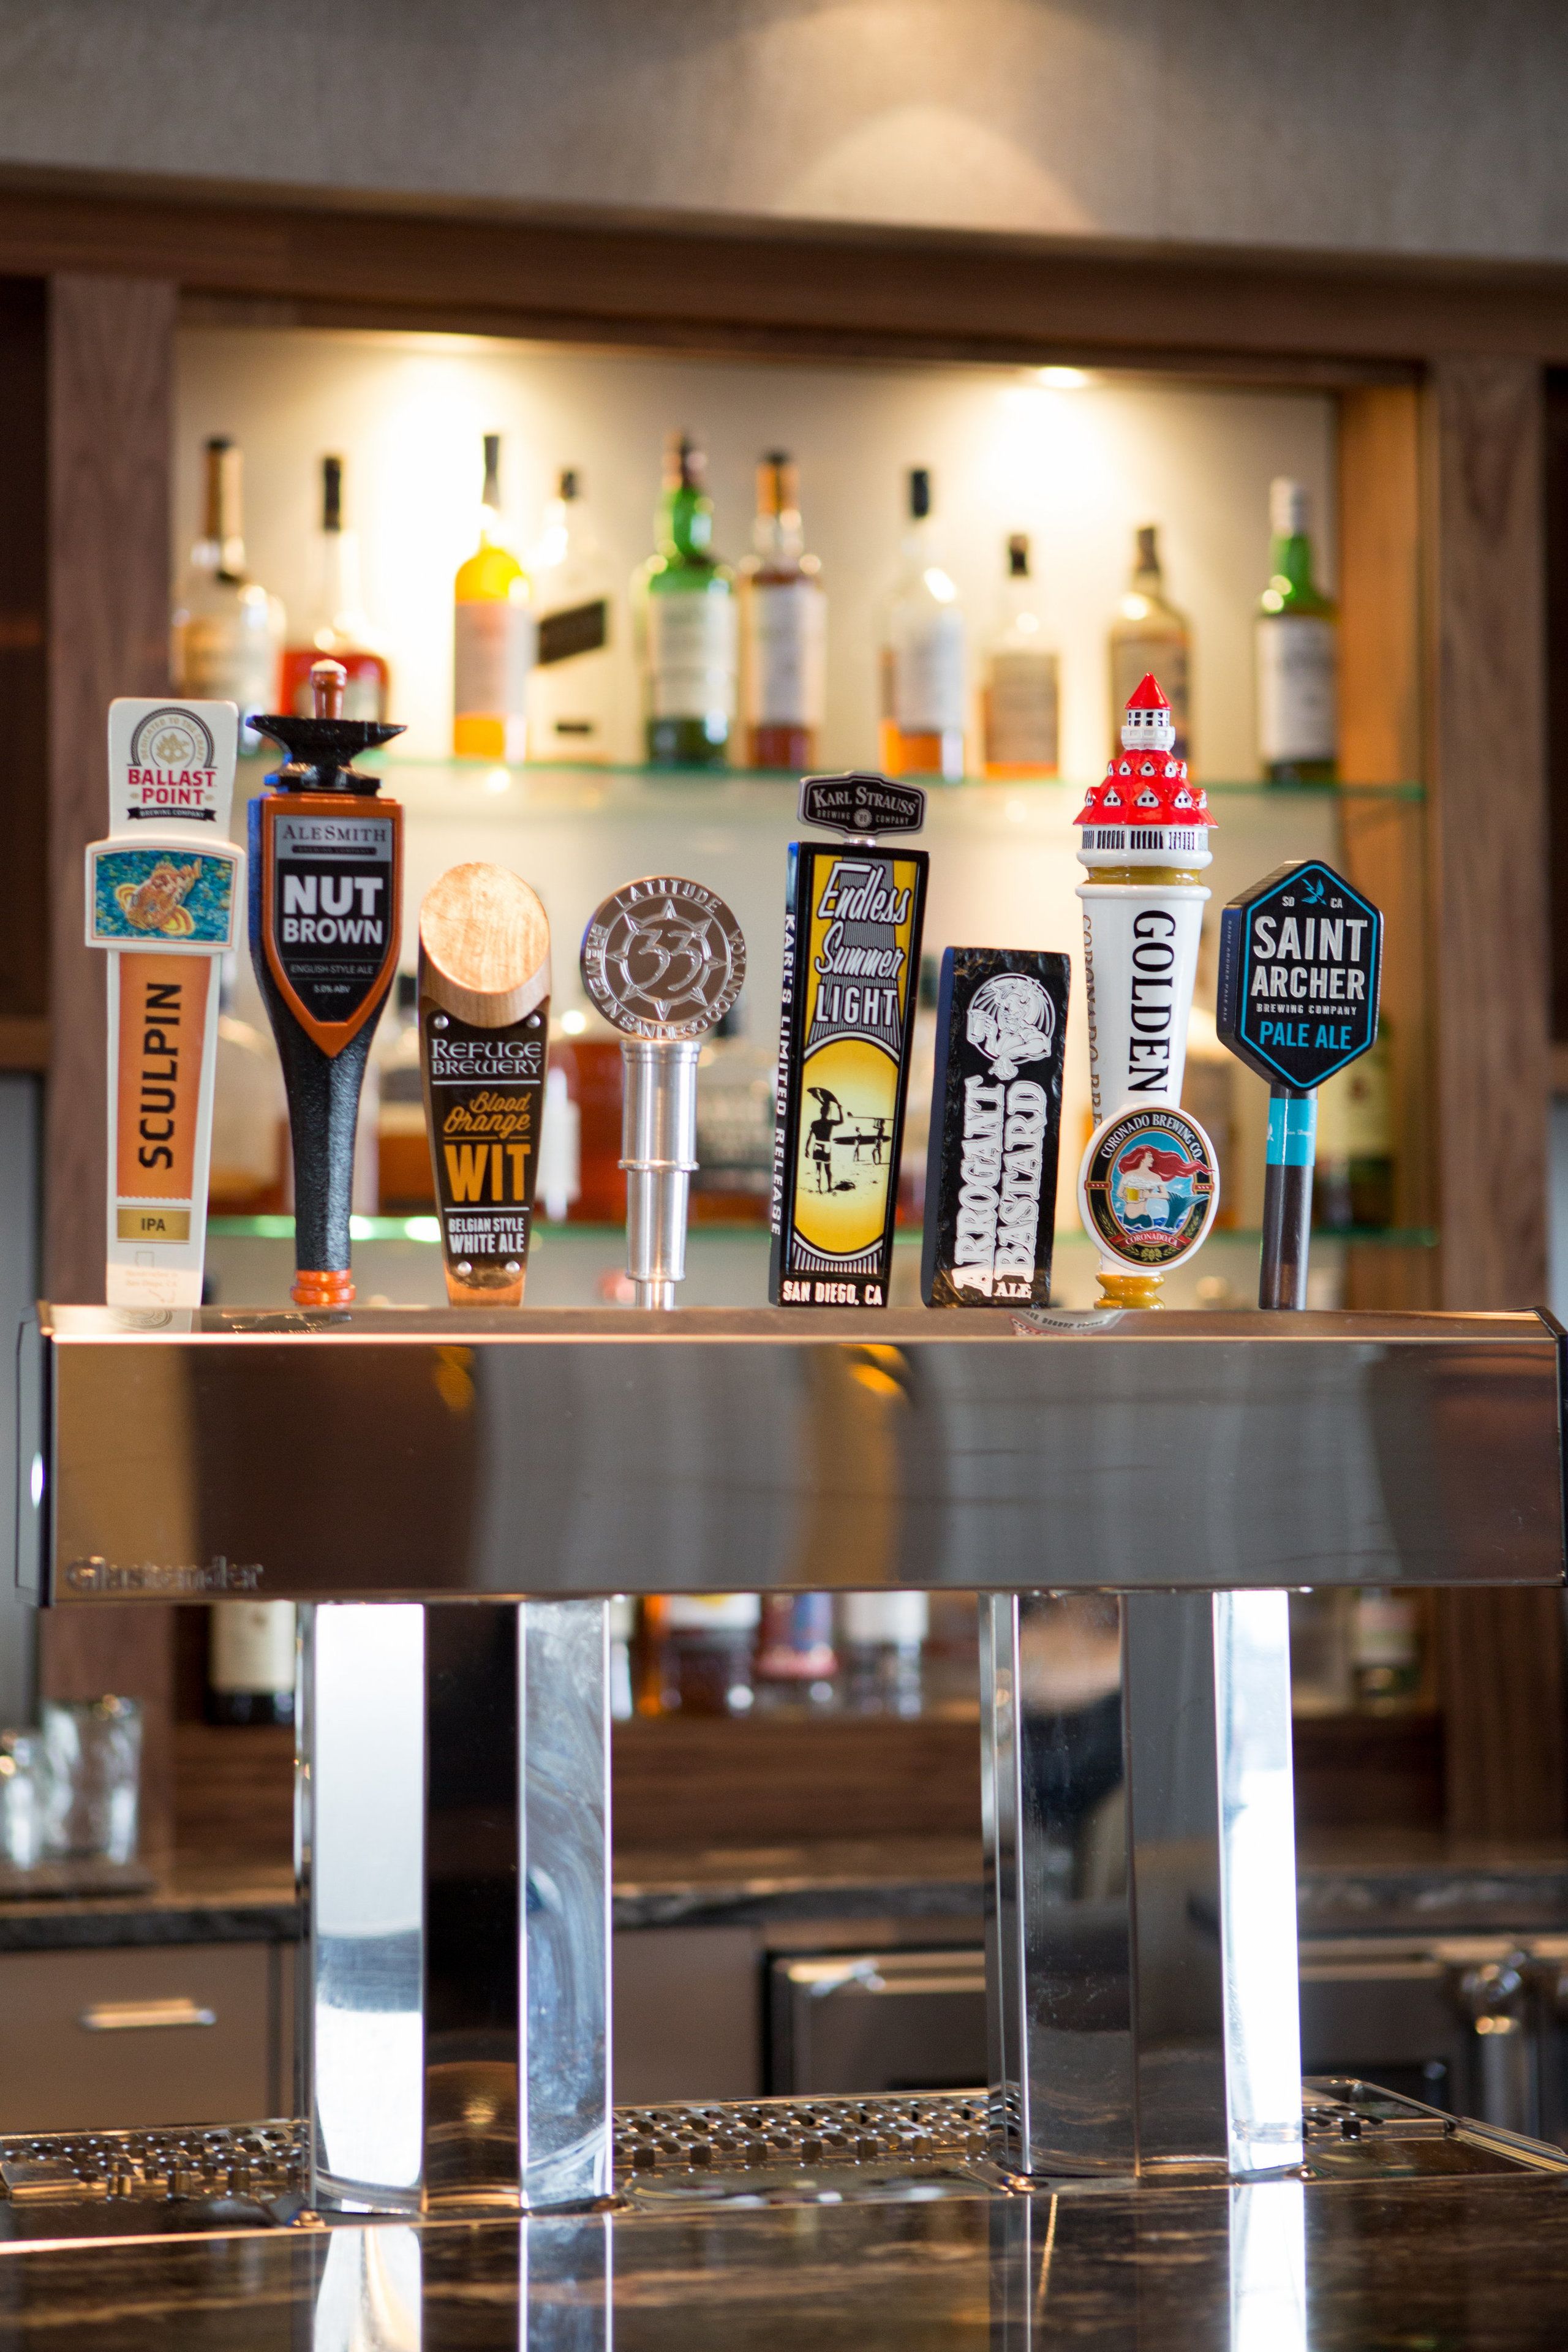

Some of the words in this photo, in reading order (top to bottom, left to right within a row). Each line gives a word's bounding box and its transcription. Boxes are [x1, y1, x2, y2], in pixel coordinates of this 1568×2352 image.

[128, 769, 216, 788] BALLAST
[142, 787, 204, 805] POINT
[816, 810, 851, 821] BREWING
[875, 815, 910, 825] COMPANY
[283, 875, 383, 916] NUT
[614, 878, 722, 913] LATITUDE
[818, 862, 911, 924] Endless
[1282, 895, 1295, 907] SO
[1330, 897, 1343, 909] CA
[283, 919, 383, 945] BROWN
[1253, 915, 1368, 962] SAINT
[635, 928, 703, 992] 33
[782, 914, 796, 1003] KARL'S
[815, 922, 905, 978] Summer
[357, 965, 374, 974] ALE
[585, 923, 608, 1000] BREWED
[600, 1000, 624, 1019] IN
[619, 1016, 656, 1039] SAN
[1250, 965, 1365, 1000] ARCHER
[816, 984, 898, 1027] LIGHT
[1083, 914, 1099, 1063] CORONADO
[1128, 909, 1177, 1093] GOLDEN
[1256, 1003, 1304, 1014] BREWING
[1308, 1005, 1357, 1016] COMPANY
[1259, 1020, 1310, 1048] PALE
[1316, 1024, 1352, 1050] ALE
[138, 982, 183, 1170] SCULPIN
[776, 1016, 791, 1118] LIMITED
[469, 1090, 532, 1113] Blood
[443, 1105, 532, 1140] Orange
[1101, 1114, 1151, 1159] CORONADO
[1152, 1113, 1195, 1144] BREWING
[443, 1143, 532, 1202] WIT
[771, 1128, 786, 1236] RELEASE
[951, 1075, 1005, 1298] ARROGANT
[994, 1079, 1048, 1283] BASTARD
[141, 1218, 166, 1232] IPA
[448, 1218, 491, 1234] BELGIAN
[492, 1217, 524, 1233] STYLE
[448, 1233, 496, 1254] WHITE
[498, 1234, 525, 1253] ALE
[782, 1280, 811, 1302] SAN
[865, 1284, 883, 1306] CA
[995, 1281, 1032, 1300] ALE
